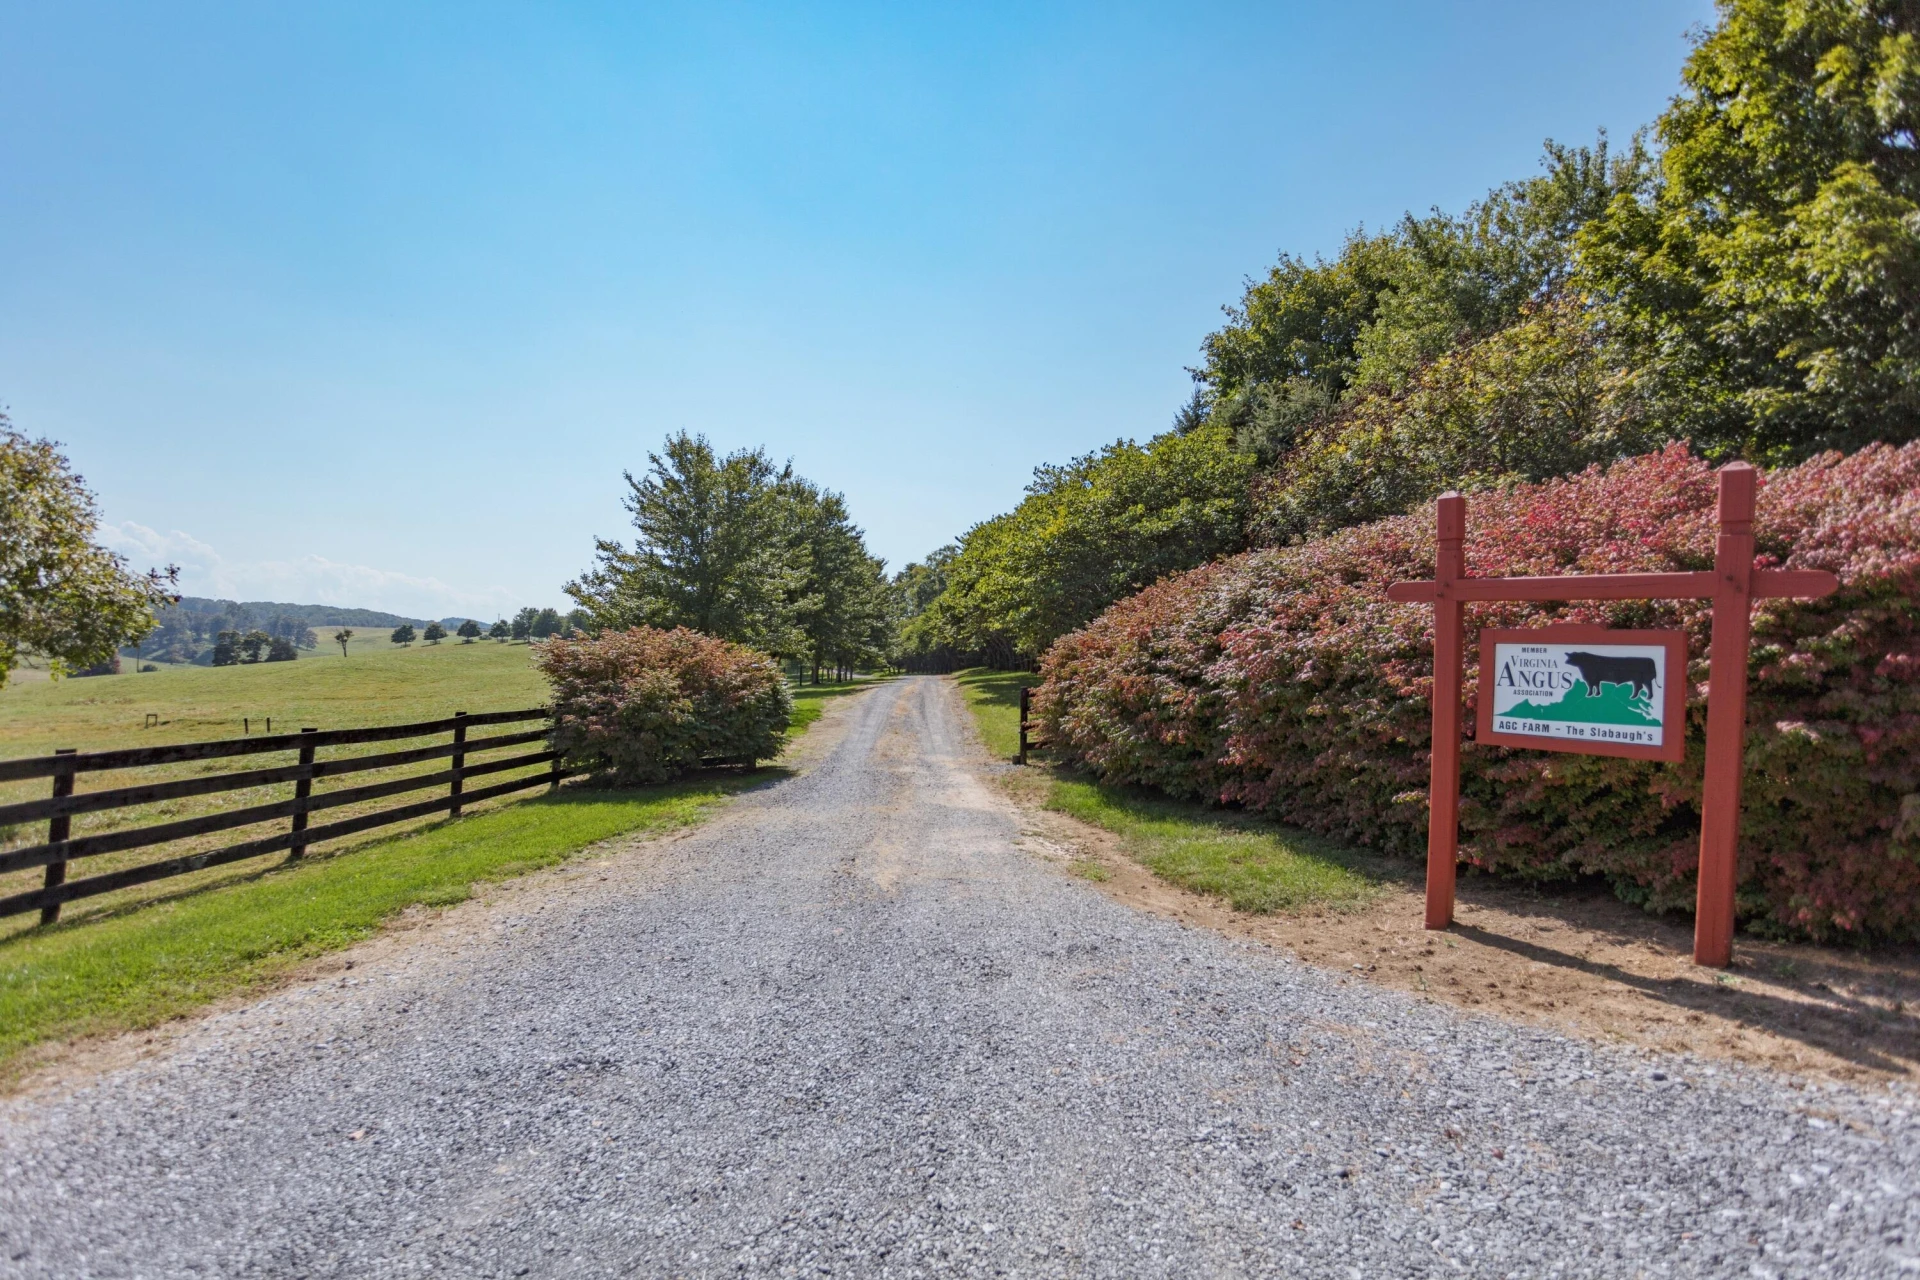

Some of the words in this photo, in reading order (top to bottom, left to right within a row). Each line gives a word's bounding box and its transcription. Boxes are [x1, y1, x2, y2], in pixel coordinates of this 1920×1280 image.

[1511, 655, 1558, 668] VIRGINIA
[1496, 661, 1572, 689] ANGUS
[1513, 689, 1553, 697] ASSOCIATION
[1499, 721, 1517, 730] AGC
[1522, 722, 1550, 733] FARM
[1566, 725, 1584, 736] The
[1590, 727, 1653, 741] Slabaugh's
